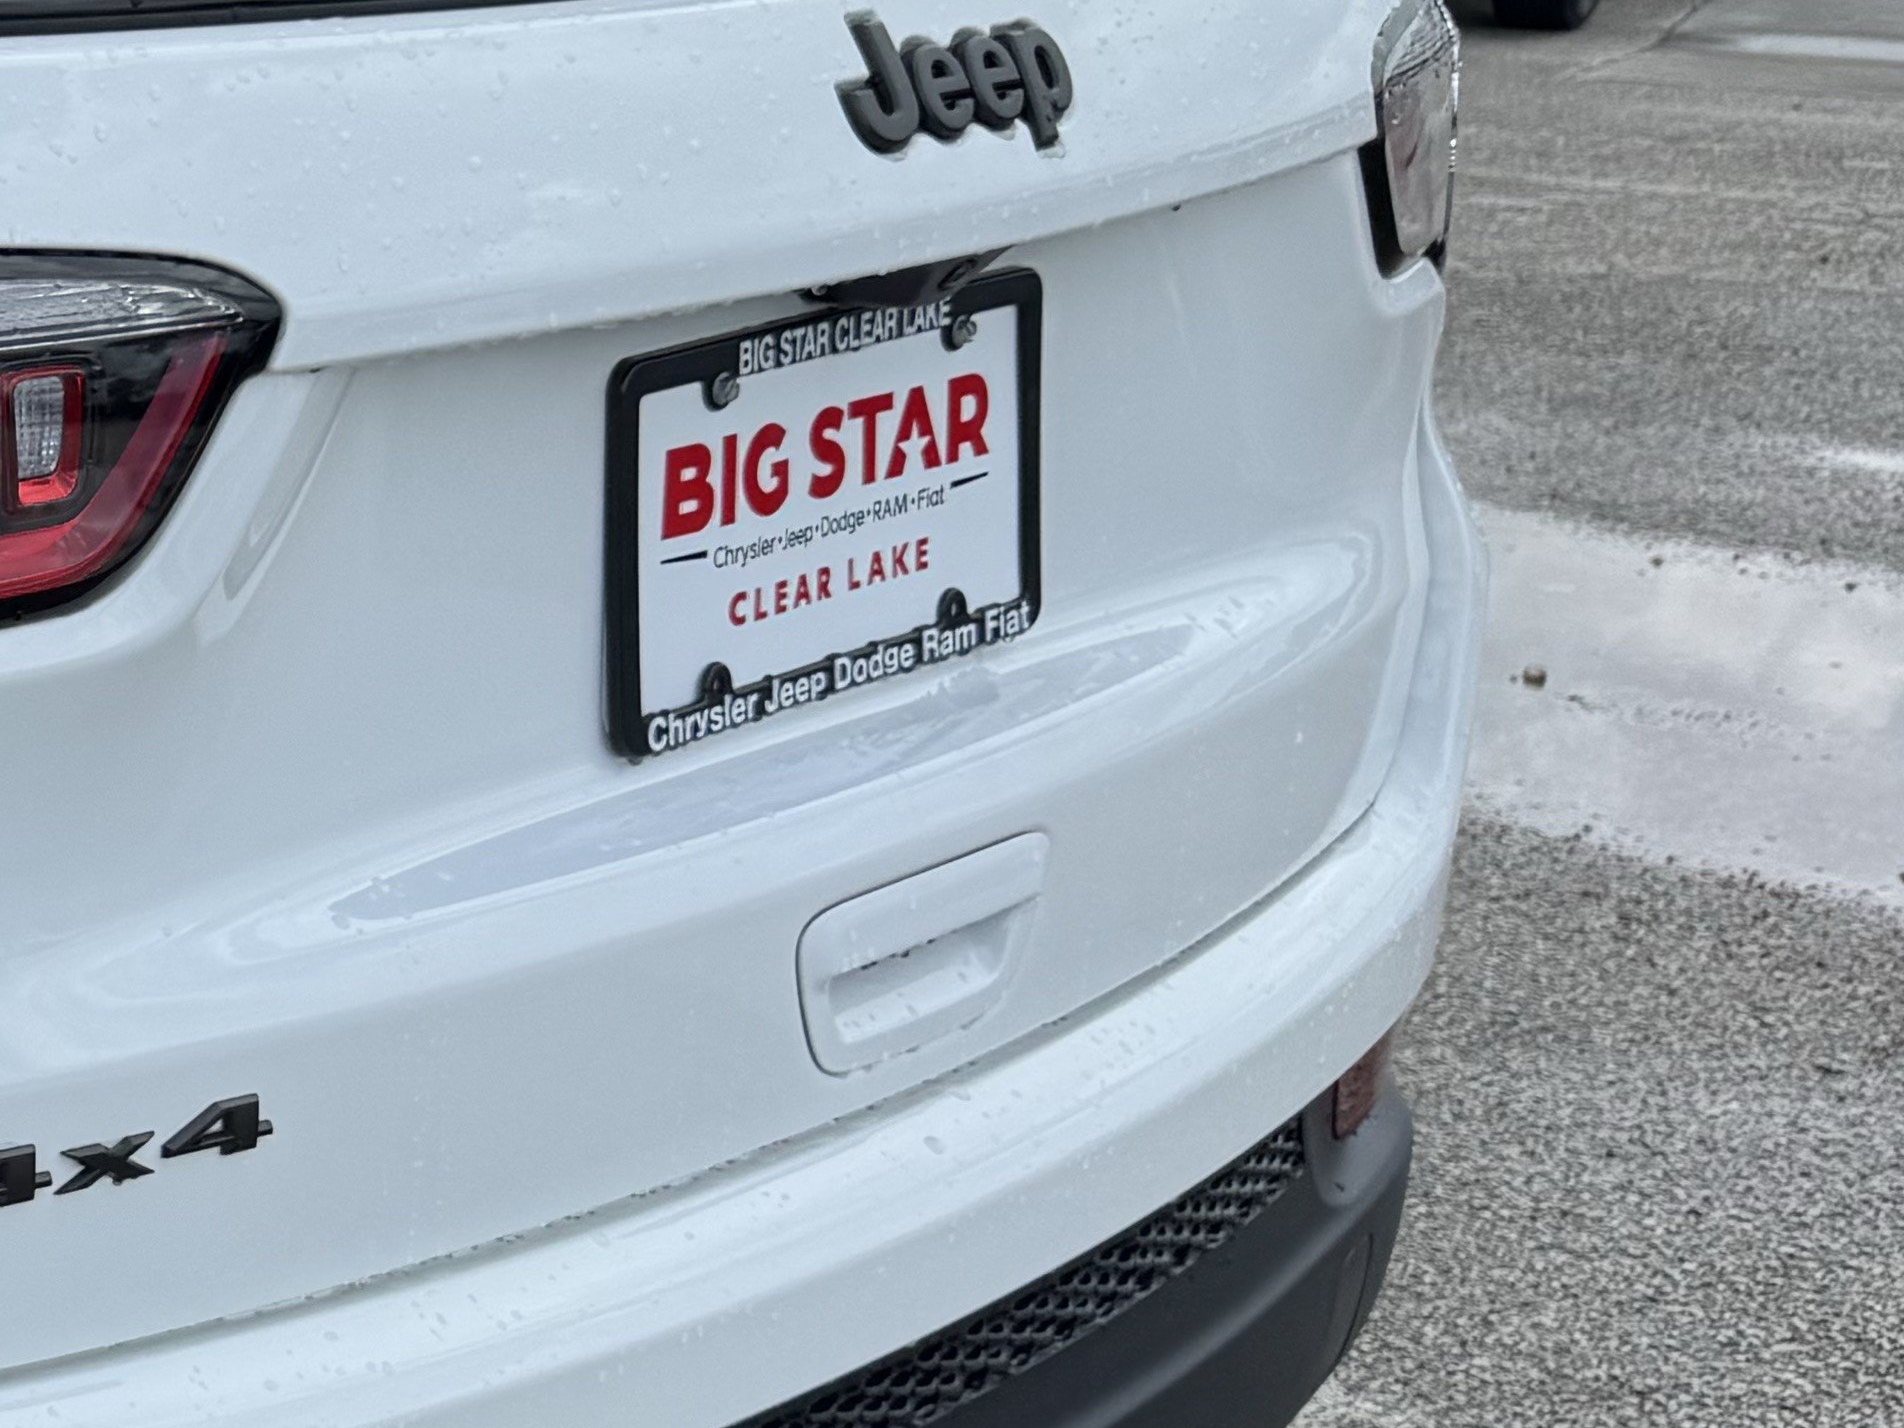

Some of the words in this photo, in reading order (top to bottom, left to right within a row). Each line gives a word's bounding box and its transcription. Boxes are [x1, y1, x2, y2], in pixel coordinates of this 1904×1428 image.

[833, 9, 1073, 157] Jeep
[739, 334, 778, 374] BIG
[780, 322, 830, 365] STAR
[835, 306, 896, 352] CLEAR
[902, 297, 952, 335] LAKE
[660, 422, 790, 541] BIG
[807, 373, 990, 500] STAR
[727, 565, 833, 626] CLEAR
[847, 536, 930, 591] LAKE
[647, 690, 758, 753] Chrysler
[764, 669, 826, 714] Jeep
[833, 646, 915, 691] Dodge
[921, 618, 977, 662] Ram
[984, 603, 1031, 641] Fiat
